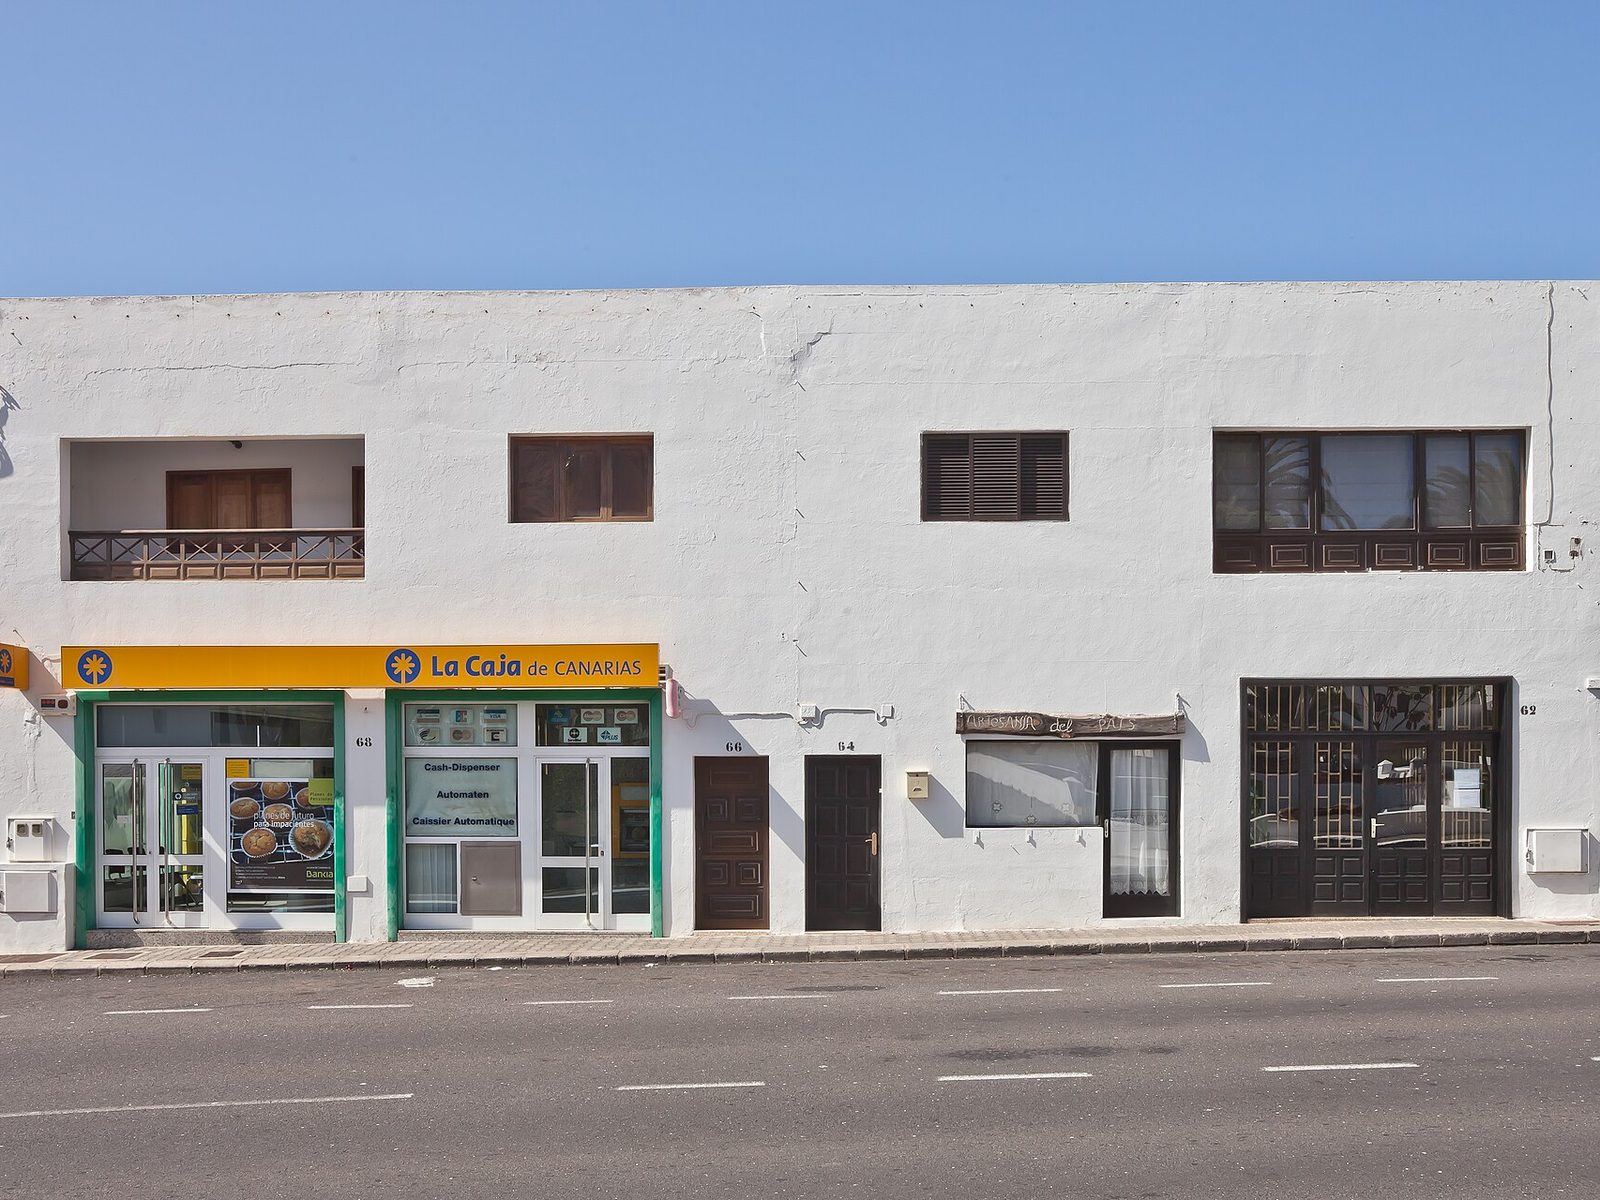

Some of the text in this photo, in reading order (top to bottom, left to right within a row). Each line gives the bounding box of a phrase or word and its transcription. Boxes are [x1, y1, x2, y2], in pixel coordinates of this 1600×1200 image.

[431, 654, 642, 677] La Caja de CANARIAS
[1520, 705, 1537, 716] 62
[1049, 717, 1073, 733] del
[356, 736, 372, 747] 68
[725, 741, 743, 753] 66
[838, 741, 855, 752] 64
[424, 763, 500, 772] Cash-Dispenser
[436, 790, 489, 799] Automaten
[253, 820, 315, 829] para impacientes
[412, 817, 515, 827] Caissier Automatique
[306, 870, 334, 878] Bankia
